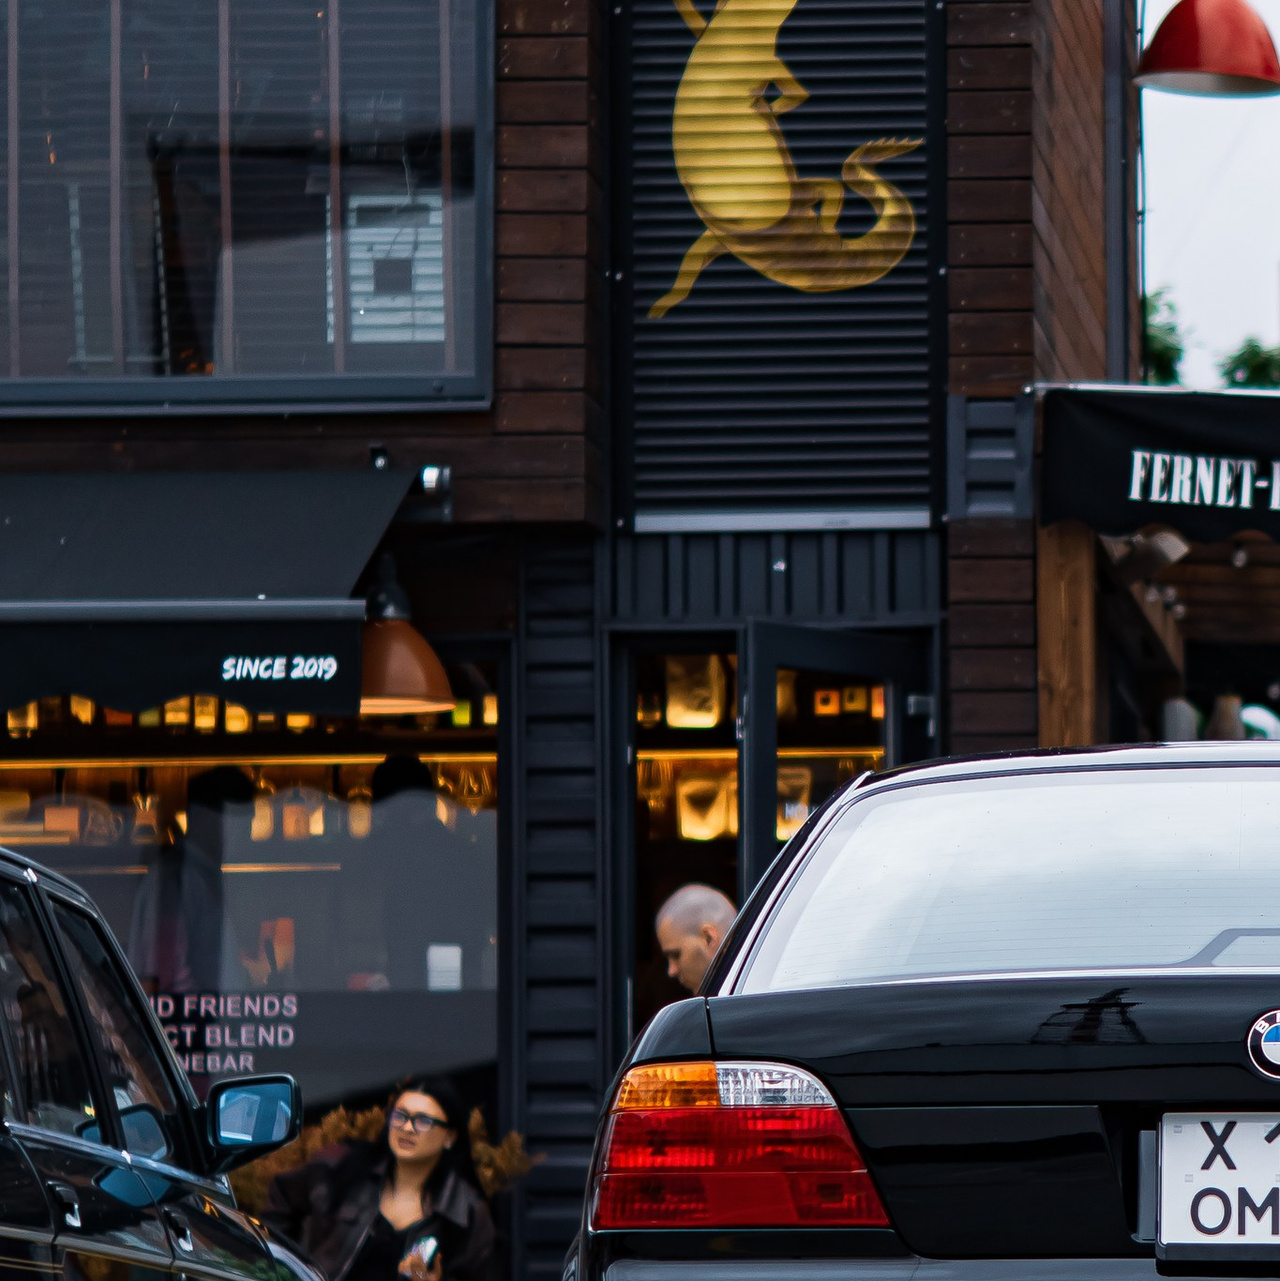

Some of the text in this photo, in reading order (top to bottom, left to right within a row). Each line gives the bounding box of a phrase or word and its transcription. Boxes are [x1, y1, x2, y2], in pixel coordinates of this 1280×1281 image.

[222, 655, 337, 680] SINCE 2019
[183, 995, 298, 1017] FRIENDS
[205, 1025, 294, 1047] BLEND
